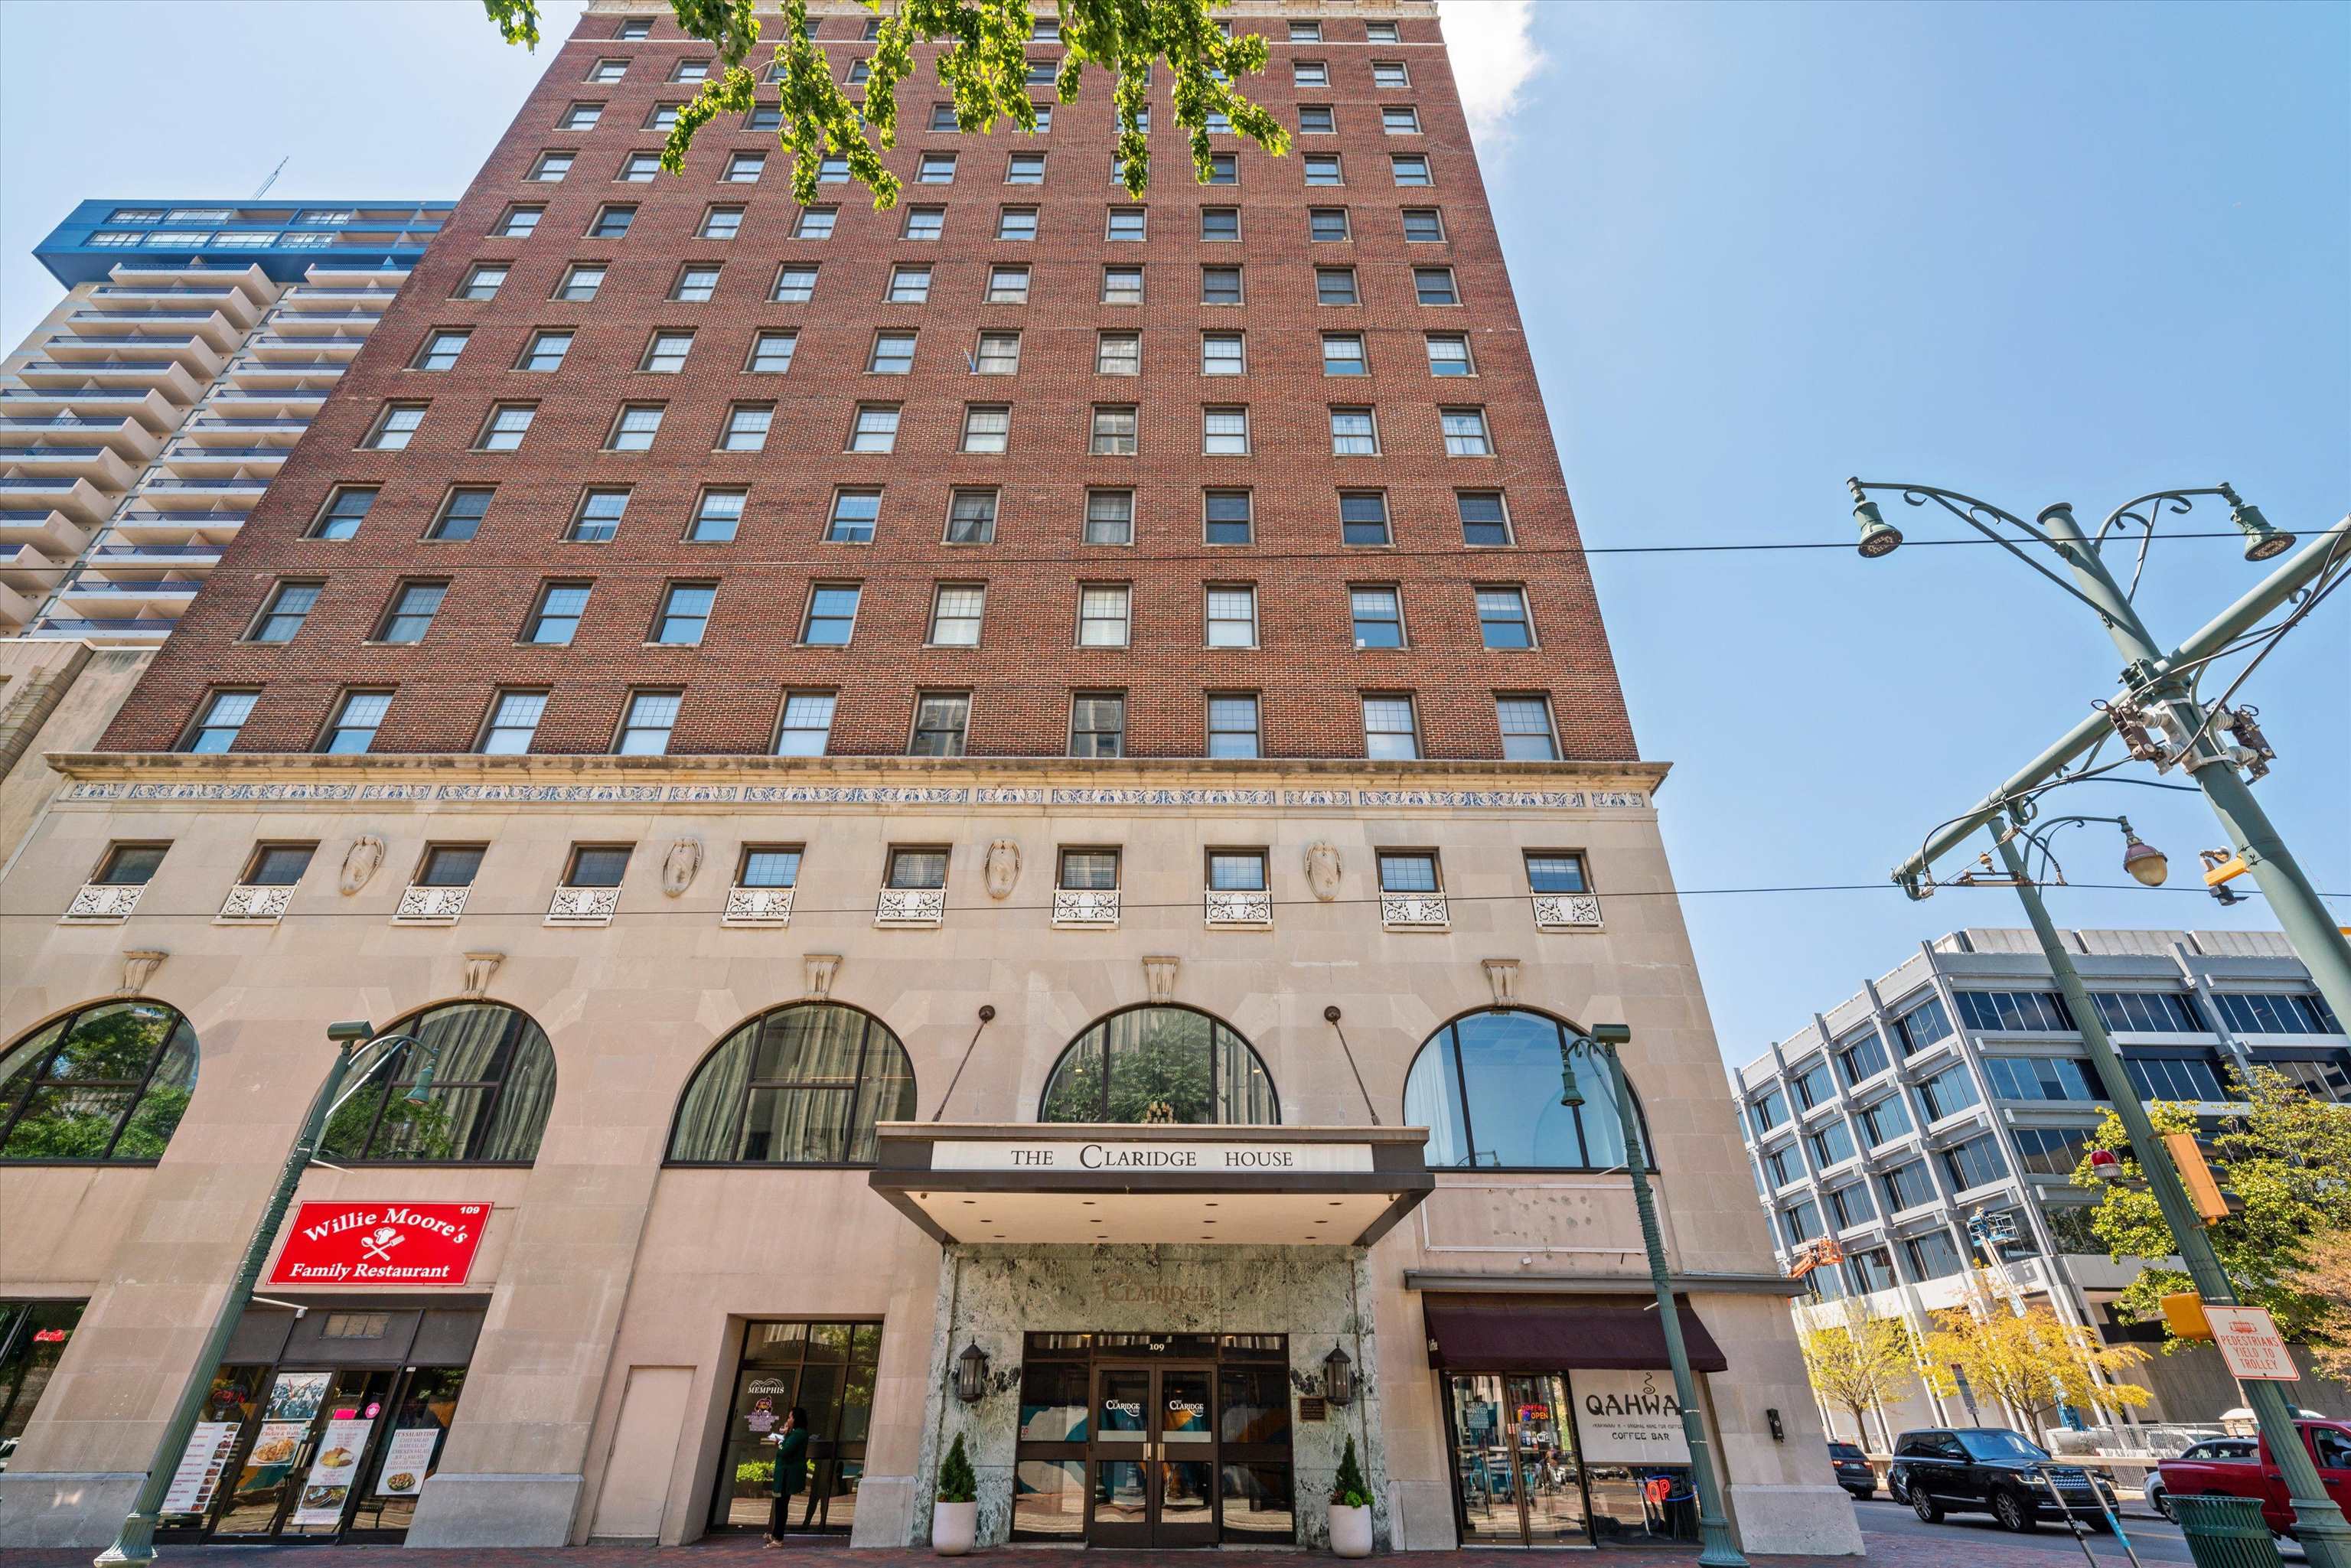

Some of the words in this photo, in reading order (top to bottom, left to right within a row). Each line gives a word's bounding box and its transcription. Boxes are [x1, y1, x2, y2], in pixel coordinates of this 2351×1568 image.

[1011, 1150, 1053, 1165] THE
[1080, 1144, 1197, 1169] CLARIDGE
[1224, 1152, 1293, 1166] HOUSE
[460, 1206, 480, 1214] 109
[303, 1212, 377, 1242] Willie
[382, 1208, 468, 1244] Moore's
[289, 1263, 351, 1281] Family
[354, 1263, 450, 1278] Restaurant
[2220, 1335, 2279, 1348] PEDESTRIANS
[2233, 1348, 2259, 1358] YIELD
[2264, 1348, 2275, 1358] TO
[2239, 1358, 2278, 1370] TROLLEY
[1106, 1400, 1140, 1410] CLARIDGE
[1169, 1400, 1204, 1410] CLARIDGE
[1586, 1394, 1682, 1416] QAHWA
[1651, 1433, 1671, 1441] BAR
[1647, 1475, 1691, 1503] OPEN
